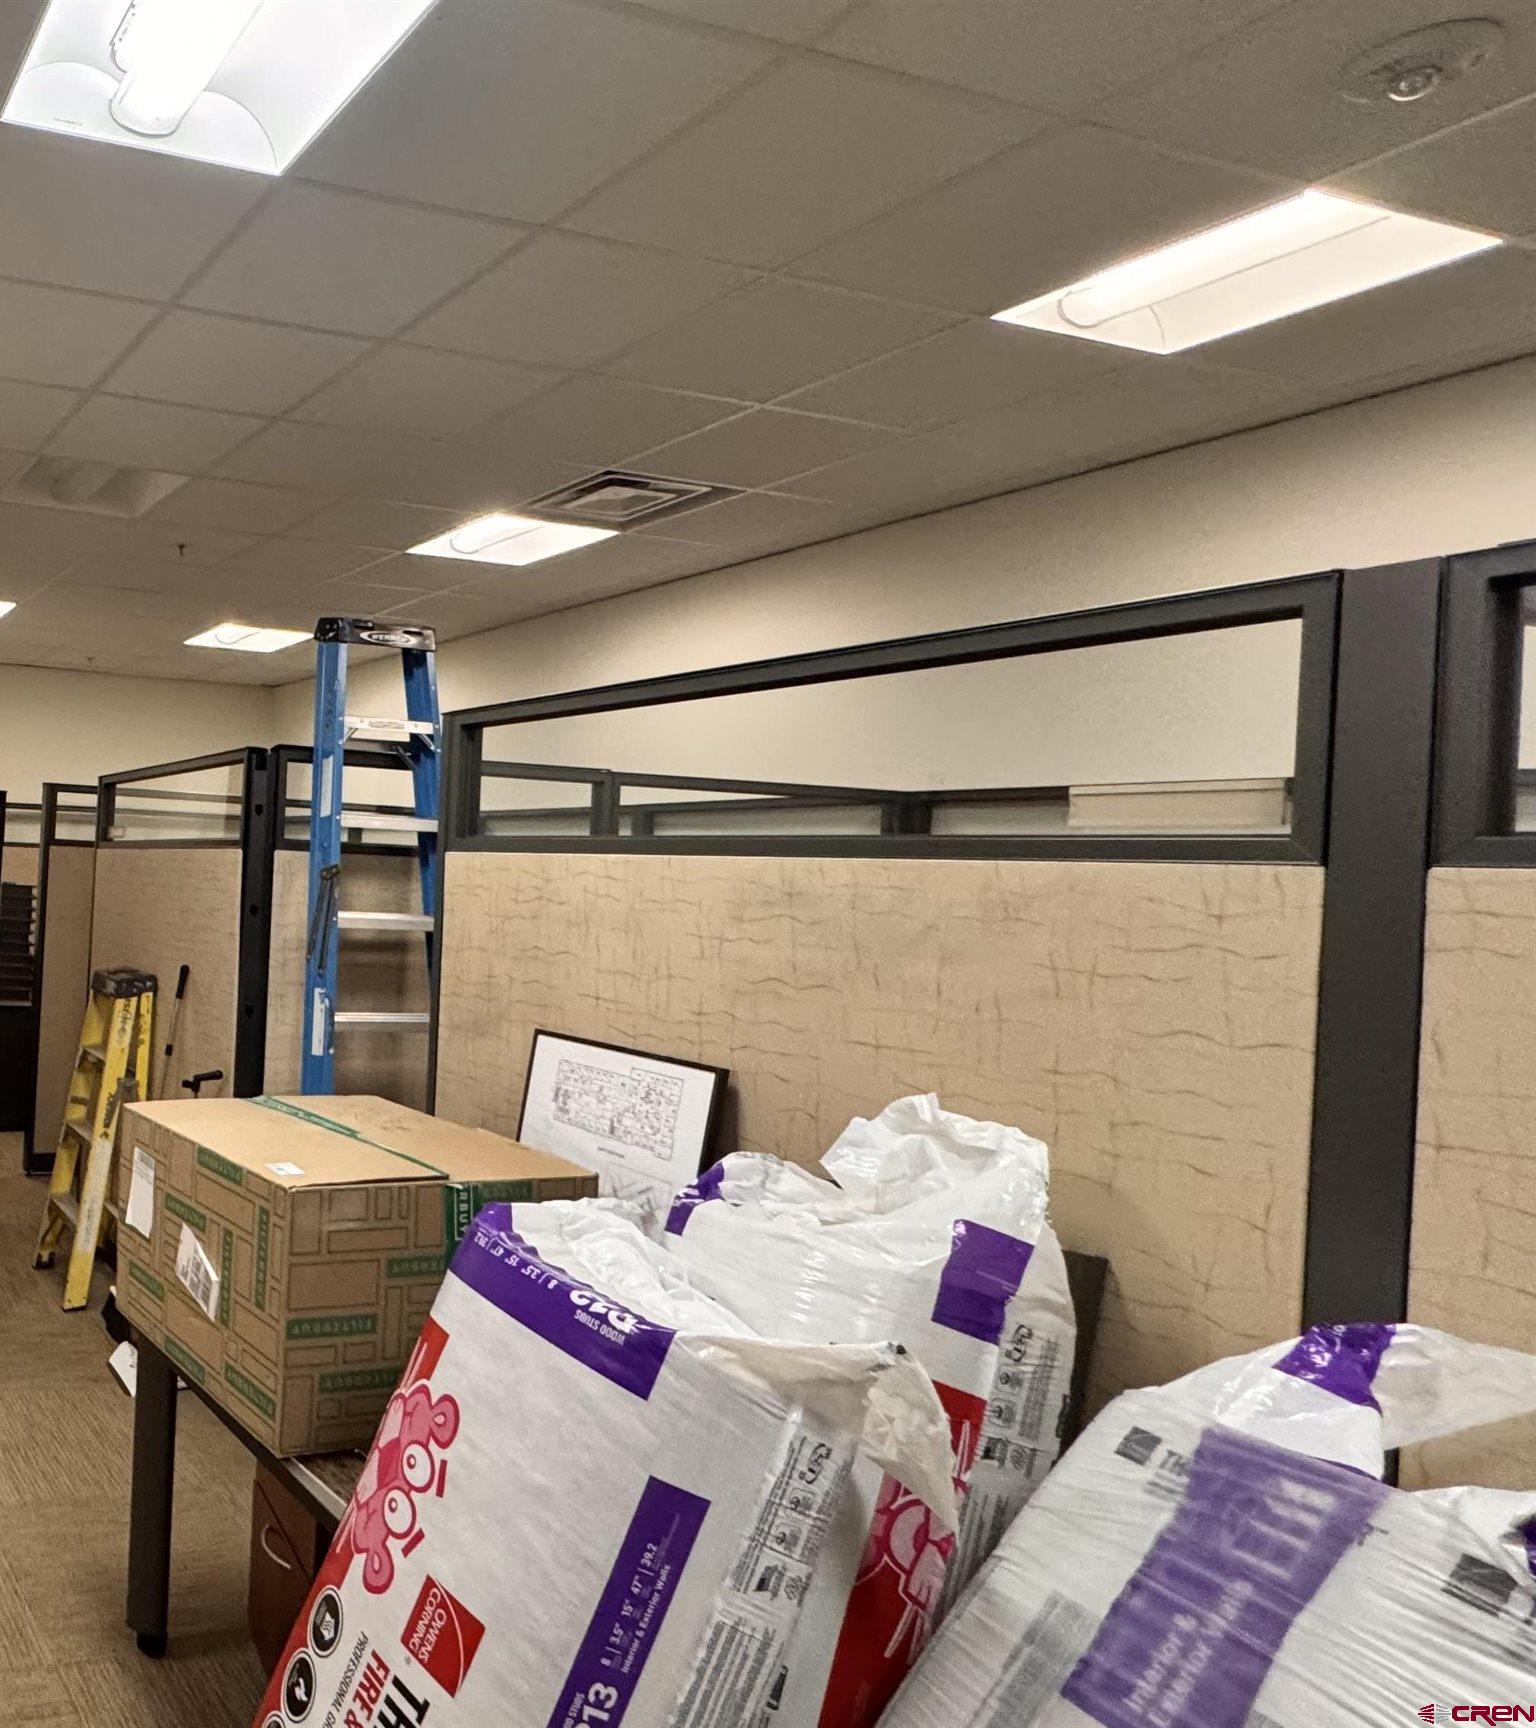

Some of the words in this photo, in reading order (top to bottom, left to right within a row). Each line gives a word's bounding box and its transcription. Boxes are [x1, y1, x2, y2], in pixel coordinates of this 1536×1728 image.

[574, 1309, 599, 1331] STUDS
[600, 1324, 626, 1346] WOOD
[409, 1588, 441, 1652] CORNING
[419, 1609, 447, 1664] OWENS
[600, 1658, 612, 1667] 8
[640, 1543, 658, 1568] 39.2
[620, 1639, 641, 1674] Interior
[642, 1591, 662, 1630] Exterior
[656, 1564, 672, 1591] Walls
[331, 1631, 369, 1713] PROFESSIONAL
[352, 1649, 390, 1722] FIRE
[575, 1682, 618, 1728] 13
